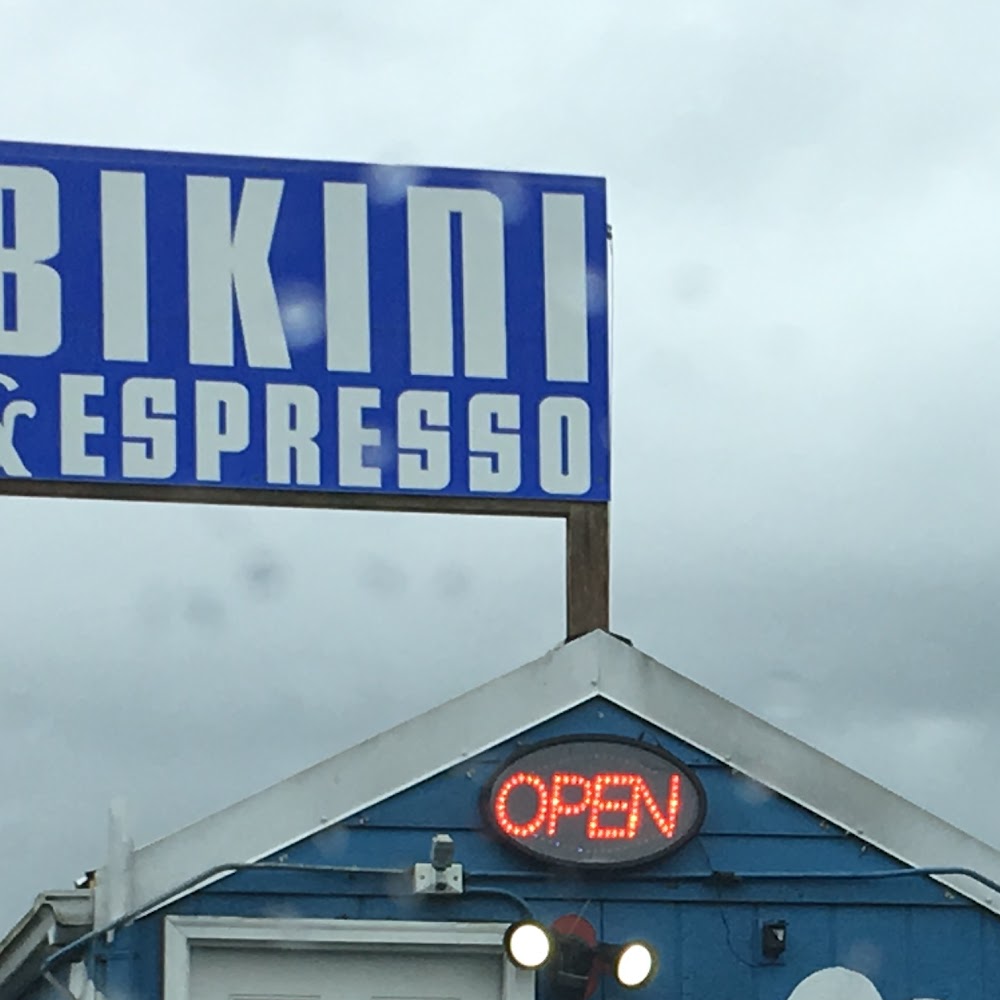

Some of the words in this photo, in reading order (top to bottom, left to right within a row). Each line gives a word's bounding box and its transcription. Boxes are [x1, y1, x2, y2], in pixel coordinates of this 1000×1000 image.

[0, 165, 589, 383] BIKINI
[60, 373, 591, 495] ESPRESSO
[495, 771, 682, 839] OPEN
